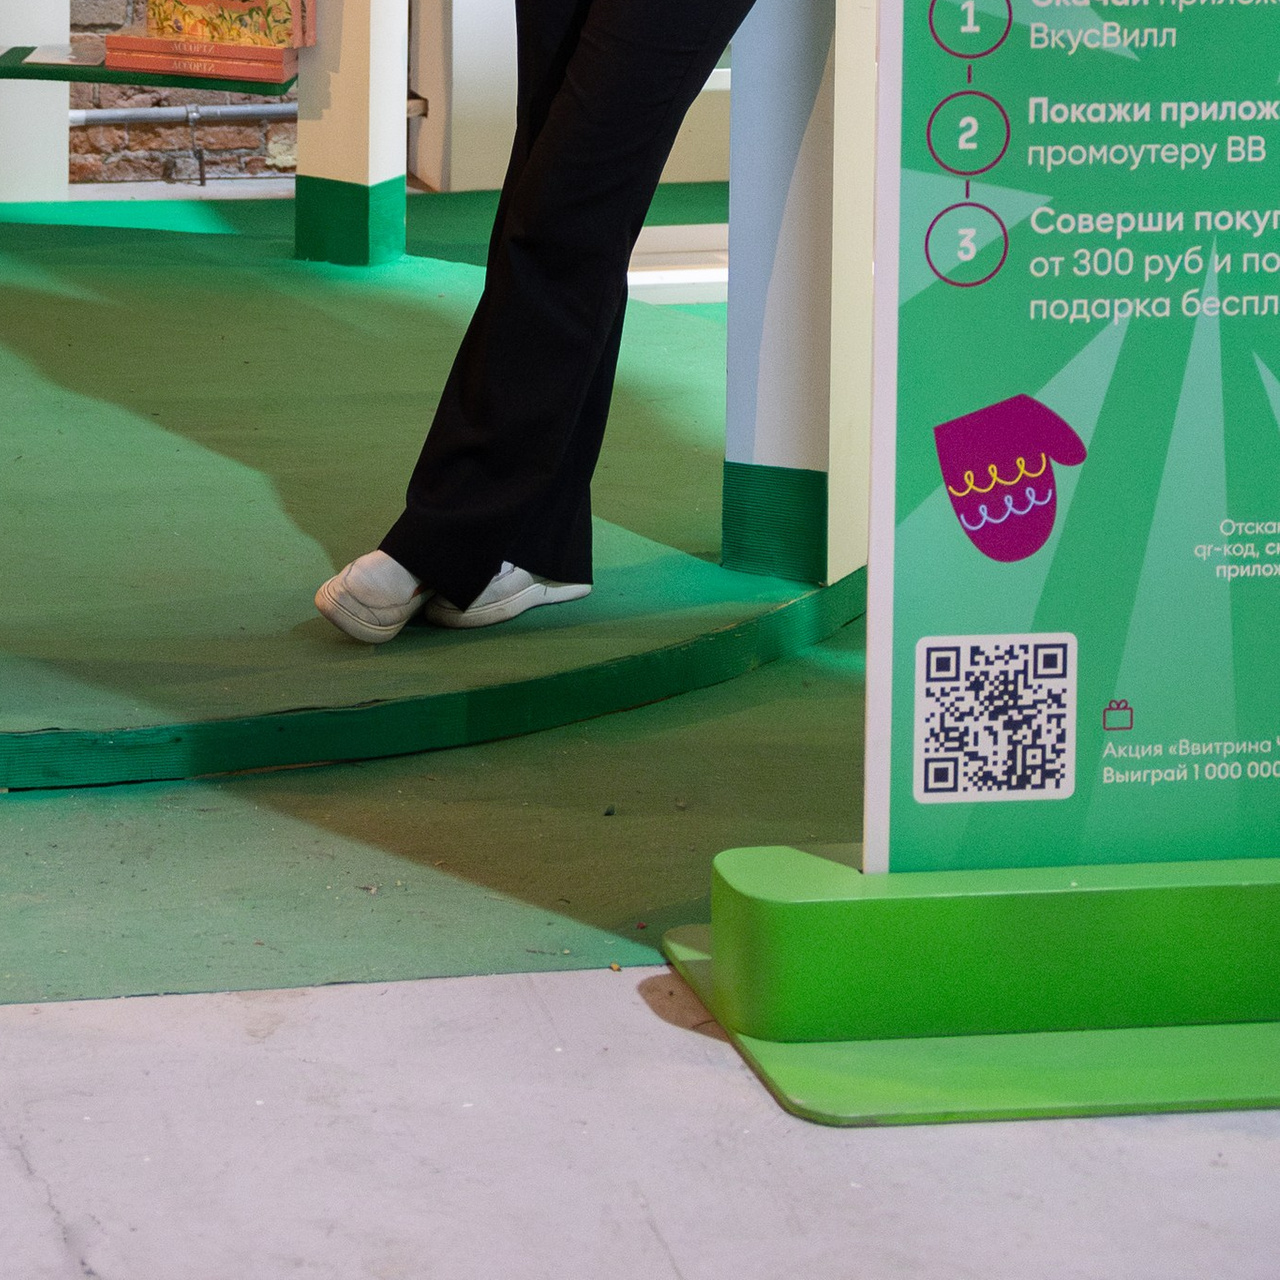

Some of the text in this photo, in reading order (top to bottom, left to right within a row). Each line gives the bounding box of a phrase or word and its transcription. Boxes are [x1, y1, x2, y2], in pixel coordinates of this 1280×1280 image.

[960, 0, 980, 33] 1
[1030, 23, 1177, 56] ВкусВилл
[1028, 97, 1151, 124] Покажи
[958, 116, 978, 150] 2
[1028, 136, 1266, 170] промоутеру ВВ
[1030, 206, 1184, 239] Соверши
[957, 229, 977, 261] 3
[1030, 245, 1280, 281] от 300 руб и по
[1030, 289, 1280, 325] подарка беспл
[1194, 542, 1260, 561] qr-код,
[1102, 741, 1163, 760] Акция
[1102, 763, 1188, 786] Выиграй
